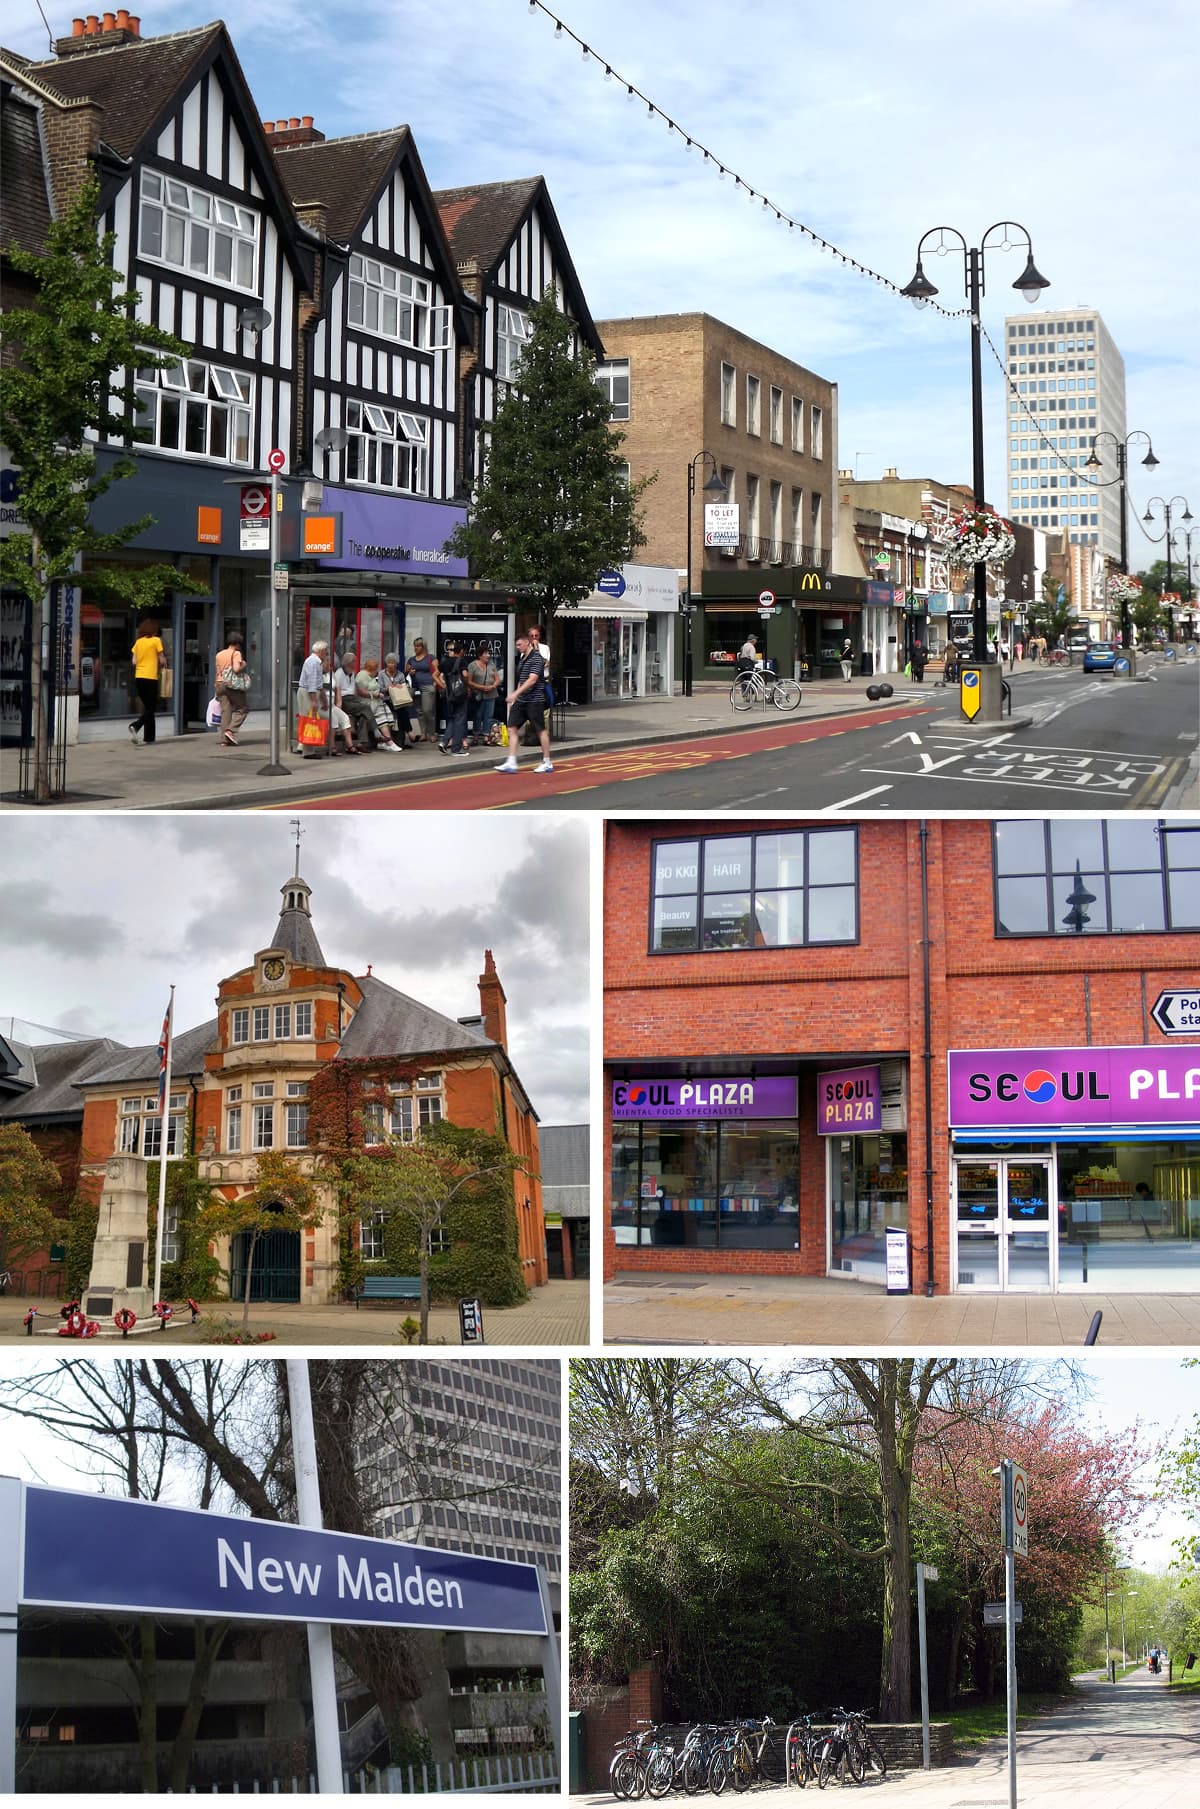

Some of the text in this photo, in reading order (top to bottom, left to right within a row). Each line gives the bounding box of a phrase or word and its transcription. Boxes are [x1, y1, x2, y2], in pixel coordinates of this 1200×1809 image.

[270, 452, 282, 467] C
[200, 533, 219, 543] orange
[305, 543, 331, 552] orange
[348, 540, 363, 557] The
[973, 750, 1167, 775] CLEAR
[962, 764, 1136, 790] KEEP
[713, 863, 741, 876] HAIR
[660, 912, 690, 920] Beauty
[680, 1083, 754, 1105] PLAZA
[826, 1080, 873, 1102] SEOUL
[969, 1069, 1110, 1104] SEOUL
[687, 1107, 744, 1115] SPECIALISTS
[826, 1101, 874, 1123] PLAZA
[1016, 1489, 1025, 1512] 20
[217, 1538, 464, 1609] New Malden
